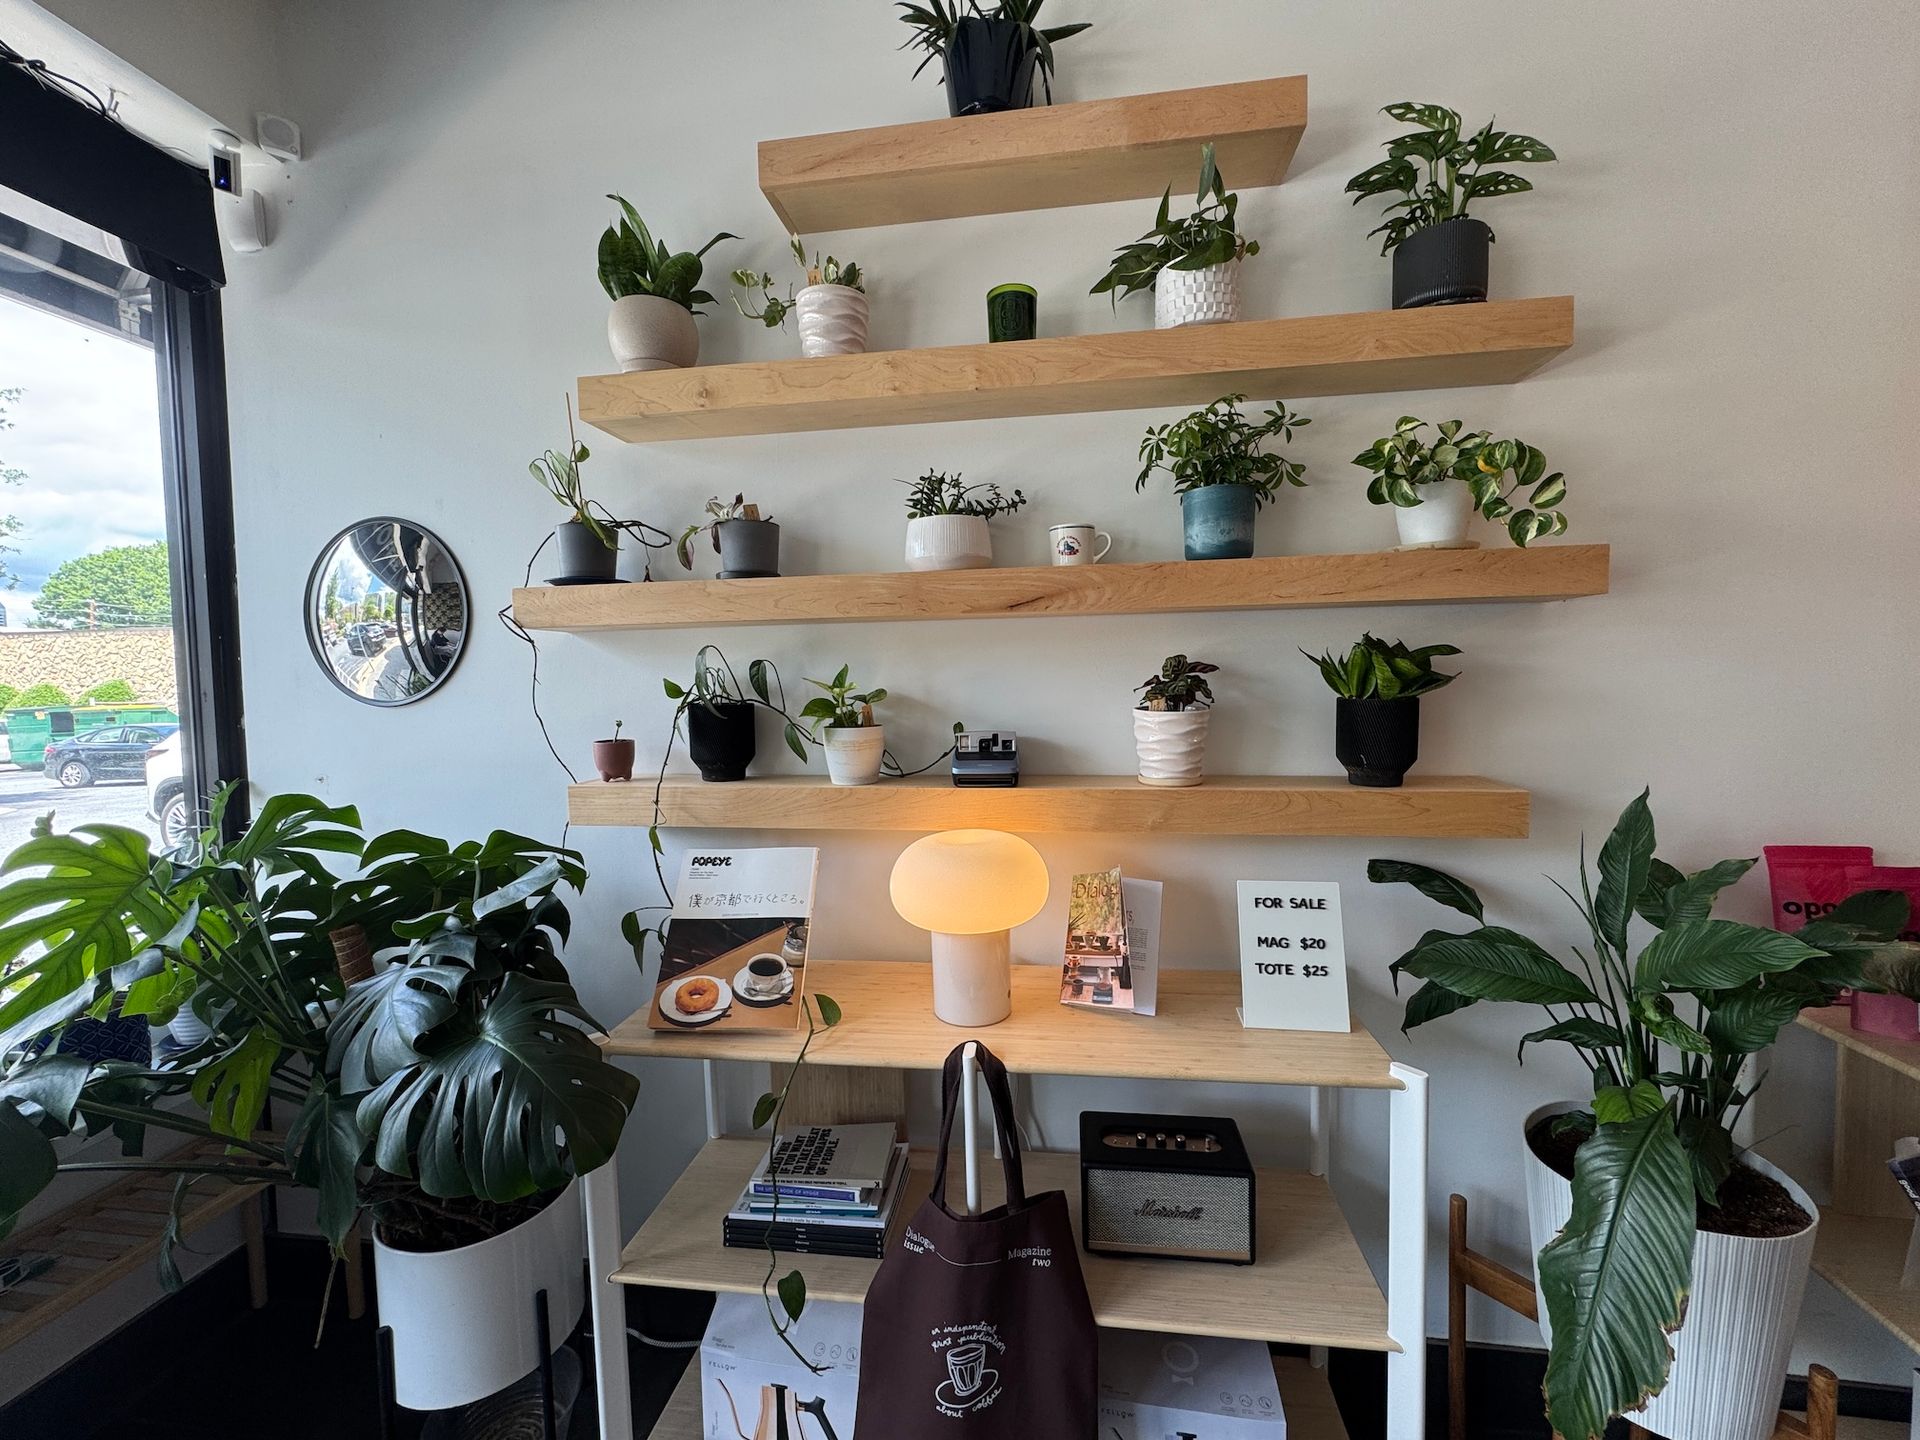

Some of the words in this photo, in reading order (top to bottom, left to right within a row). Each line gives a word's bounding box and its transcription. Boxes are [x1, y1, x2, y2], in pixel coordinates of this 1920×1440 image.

[692, 857, 732, 867] POPEYE
[688, 893, 806, 908] 僕が京都で行くところ。
[1254, 897, 1283, 909] FOR
[1289, 897, 1327, 910] SALE
[1257, 936, 1290, 949] MAG
[1300, 936, 1326, 951] $20
[1255, 962, 1294, 976] TOTE
[1302, 963, 1328, 978] $25
[789, 1135, 807, 1152] WANT
[804, 1127, 822, 1147] GREAT
[783, 1153, 798, 1166] YOU
[796, 1148, 813, 1164] TAKE
[802, 1128, 833, 1175] PHOTOGRAPHS
[778, 1165, 791, 1174] IF
[790, 1165, 805, 1175] TO
[815, 1165, 828, 1176] OF
[1135, 1199, 1204, 1220] Marshall
[903, 1237, 925, 1255] issue
[905, 1225, 936, 1253] Dialogue
[1007, 1245, 1052, 1260] Magazine
[1032, 1257, 1051, 1267] two
[930, 1327, 941, 1336] an
[943, 1320, 998, 1334] independent
[930, 1337, 952, 1353] print
[957, 1331, 1007, 1356] publication
[935, 1404, 964, 1419] about
[972, 1386, 1003, 1412] coffee
